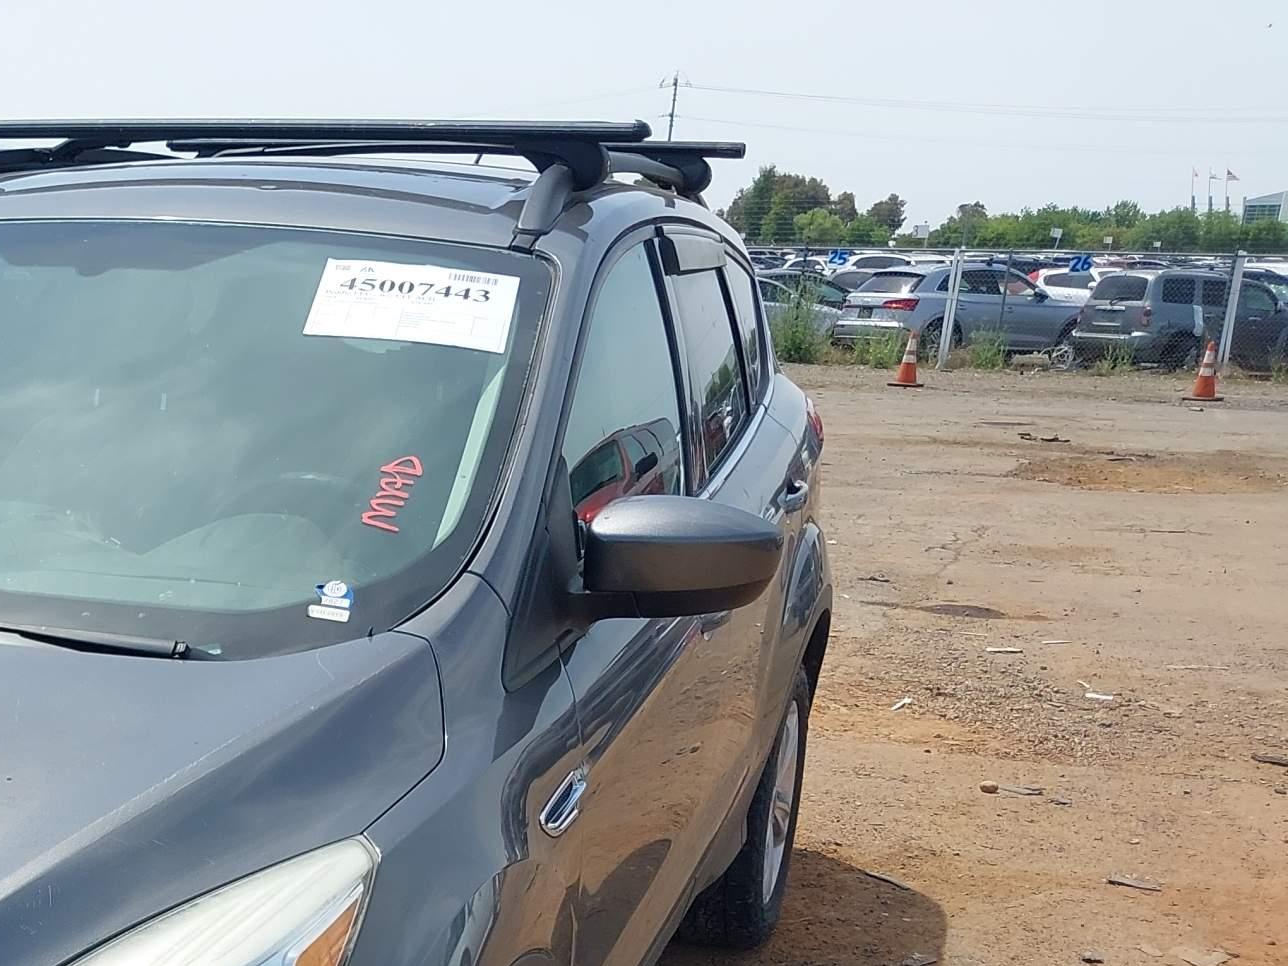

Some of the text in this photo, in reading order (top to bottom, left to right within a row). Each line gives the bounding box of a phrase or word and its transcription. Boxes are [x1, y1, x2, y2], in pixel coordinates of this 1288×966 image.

[829, 251, 847, 265] 25
[1070, 255, 1092, 272] 26
[339, 277, 491, 303] 45007443
